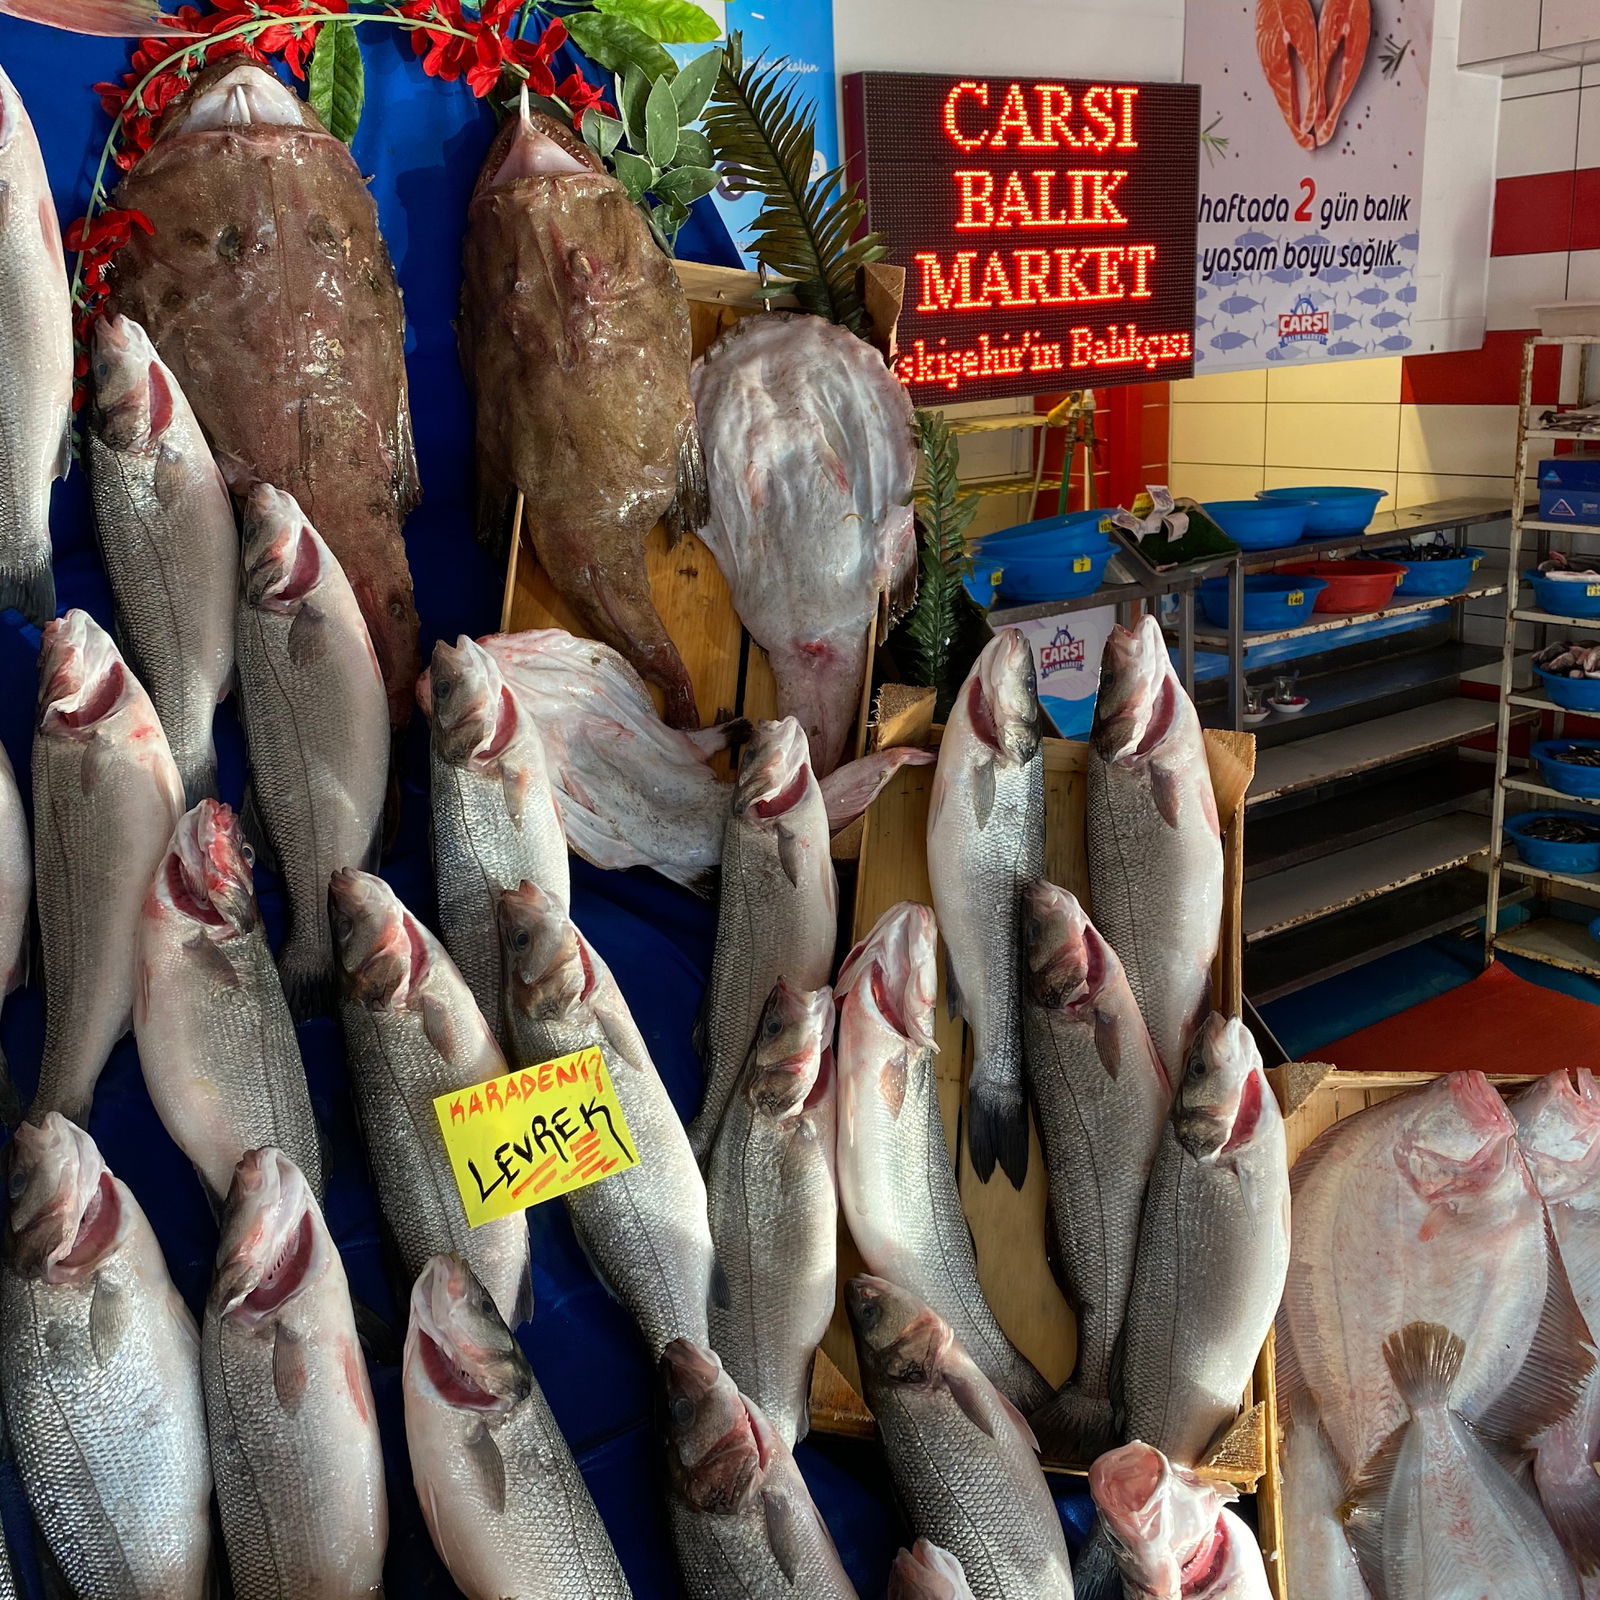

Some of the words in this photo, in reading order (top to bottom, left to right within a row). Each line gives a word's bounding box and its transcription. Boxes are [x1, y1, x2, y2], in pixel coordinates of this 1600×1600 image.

[943, 81, 1139, 151] ÇARŞI
[954, 169, 1130, 230] BALIK
[1198, 194, 1289, 223] haftada
[1294, 177, 1316, 222] 2
[1321, 192, 1358, 230] gün
[1364, 194, 1410, 221] balık
[915, 245, 1157, 312] MARKET
[1203, 247, 1277, 281] yaşam
[1283, 241, 1336, 276] boyu
[1339, 239, 1401, 275] sağlık.
[1280, 313, 1328, 334] ÇARŞI
[894, 330, 1063, 388] skişehir'in
[1069, 322, 1192, 369] Balıkçısı
[1041, 641, 1083, 667] ÇARŞI
[467, 1096, 634, 1203] LEVREK
